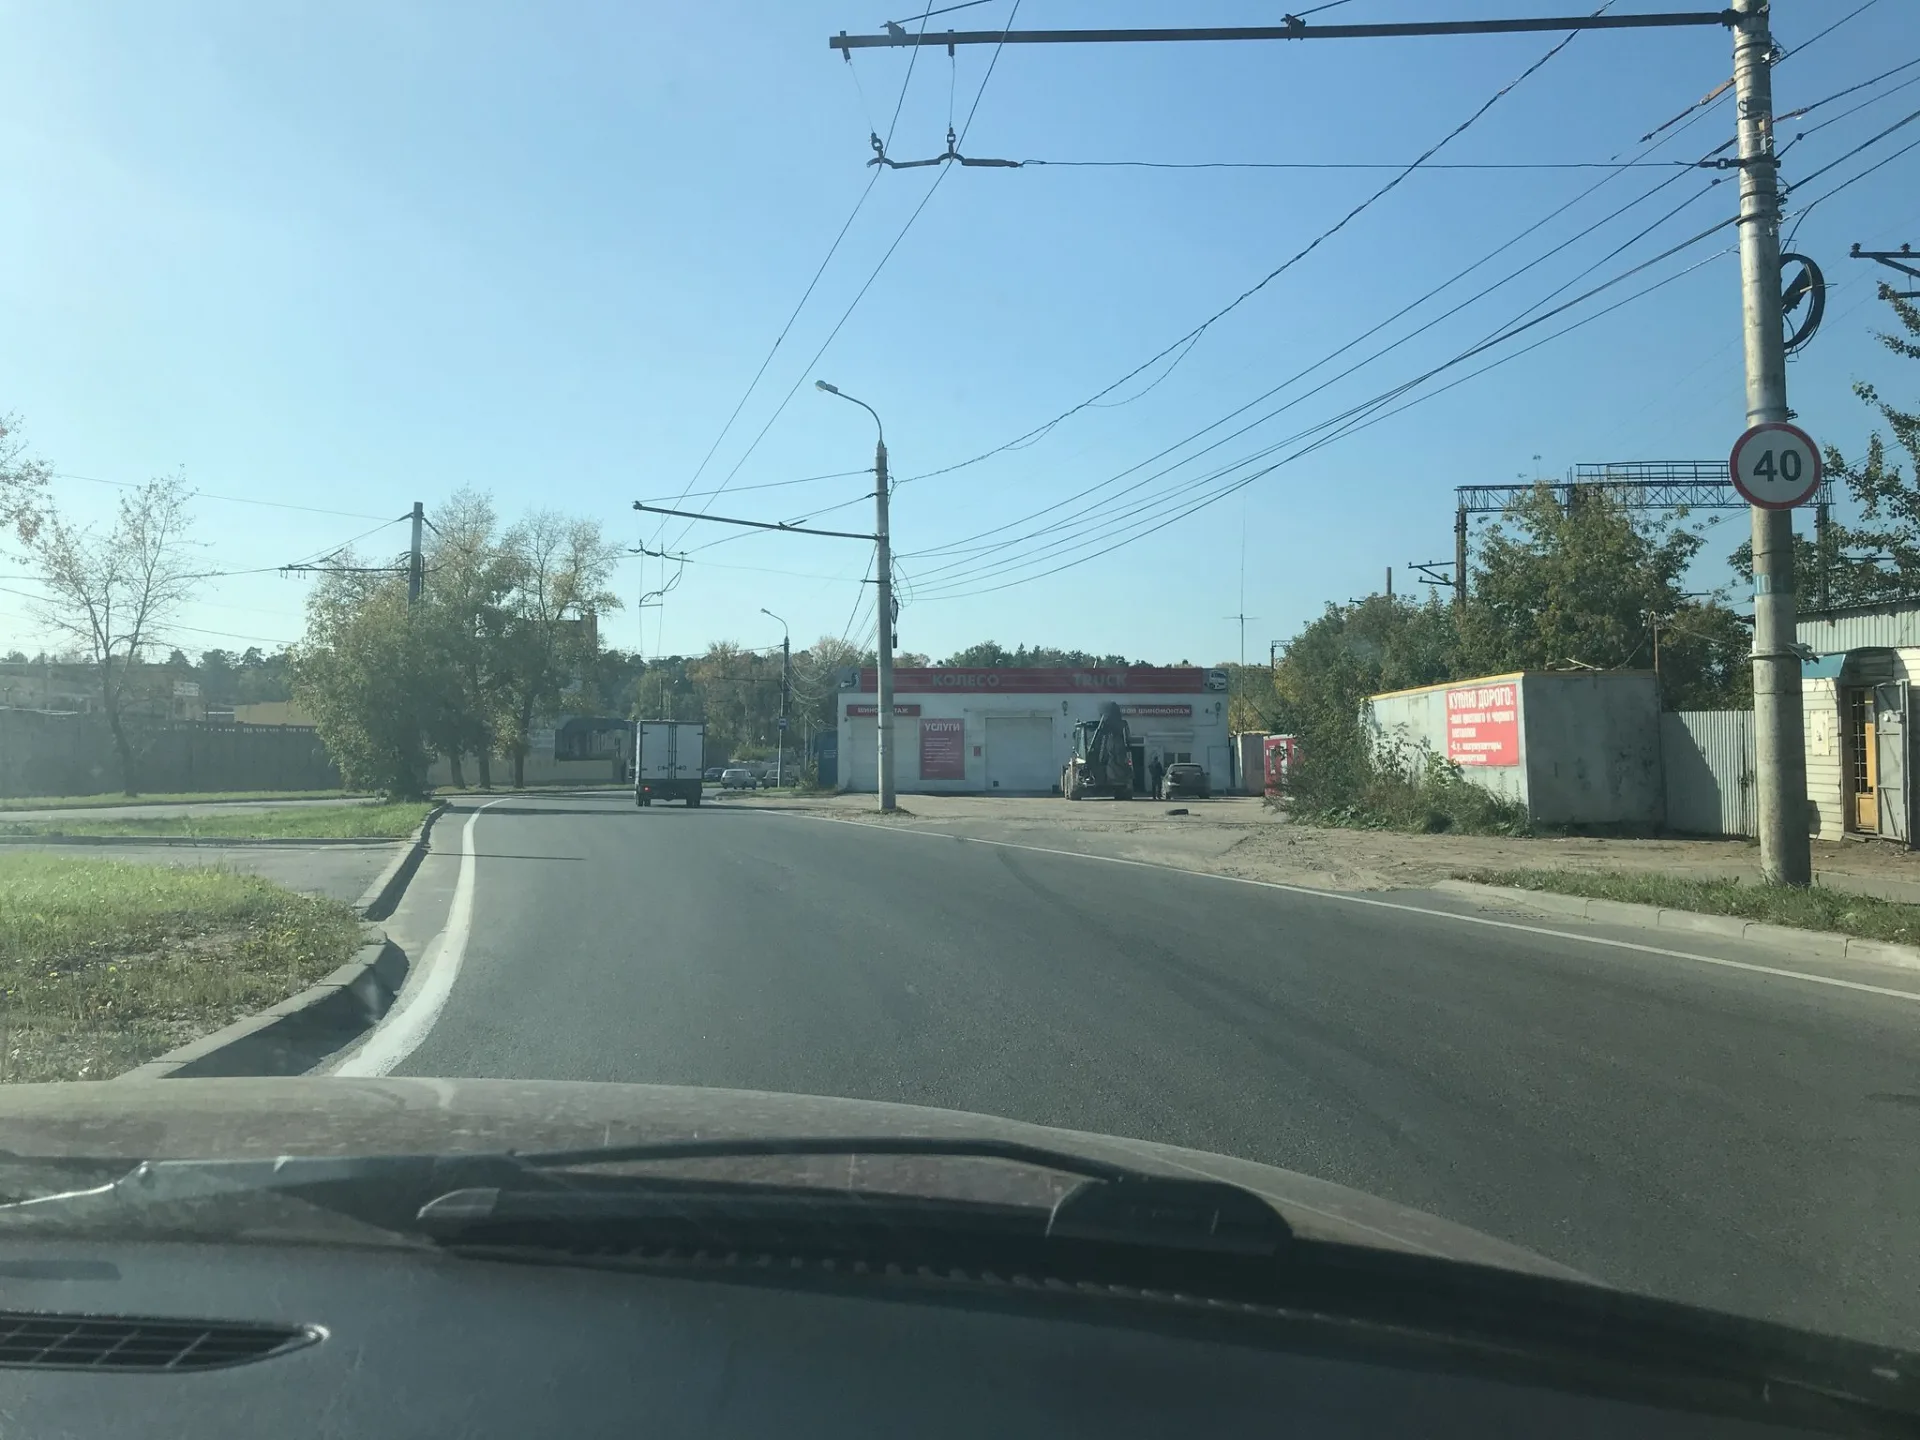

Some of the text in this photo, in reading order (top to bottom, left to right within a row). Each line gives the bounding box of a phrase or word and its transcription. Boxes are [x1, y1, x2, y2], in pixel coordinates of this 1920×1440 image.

[1753, 450, 1802, 482] 40
[932, 673, 999, 687] КОЛЕСО
[1448, 690, 1477, 709] КУПЛЮ
[924, 723, 960, 732] УСЛУГИ
